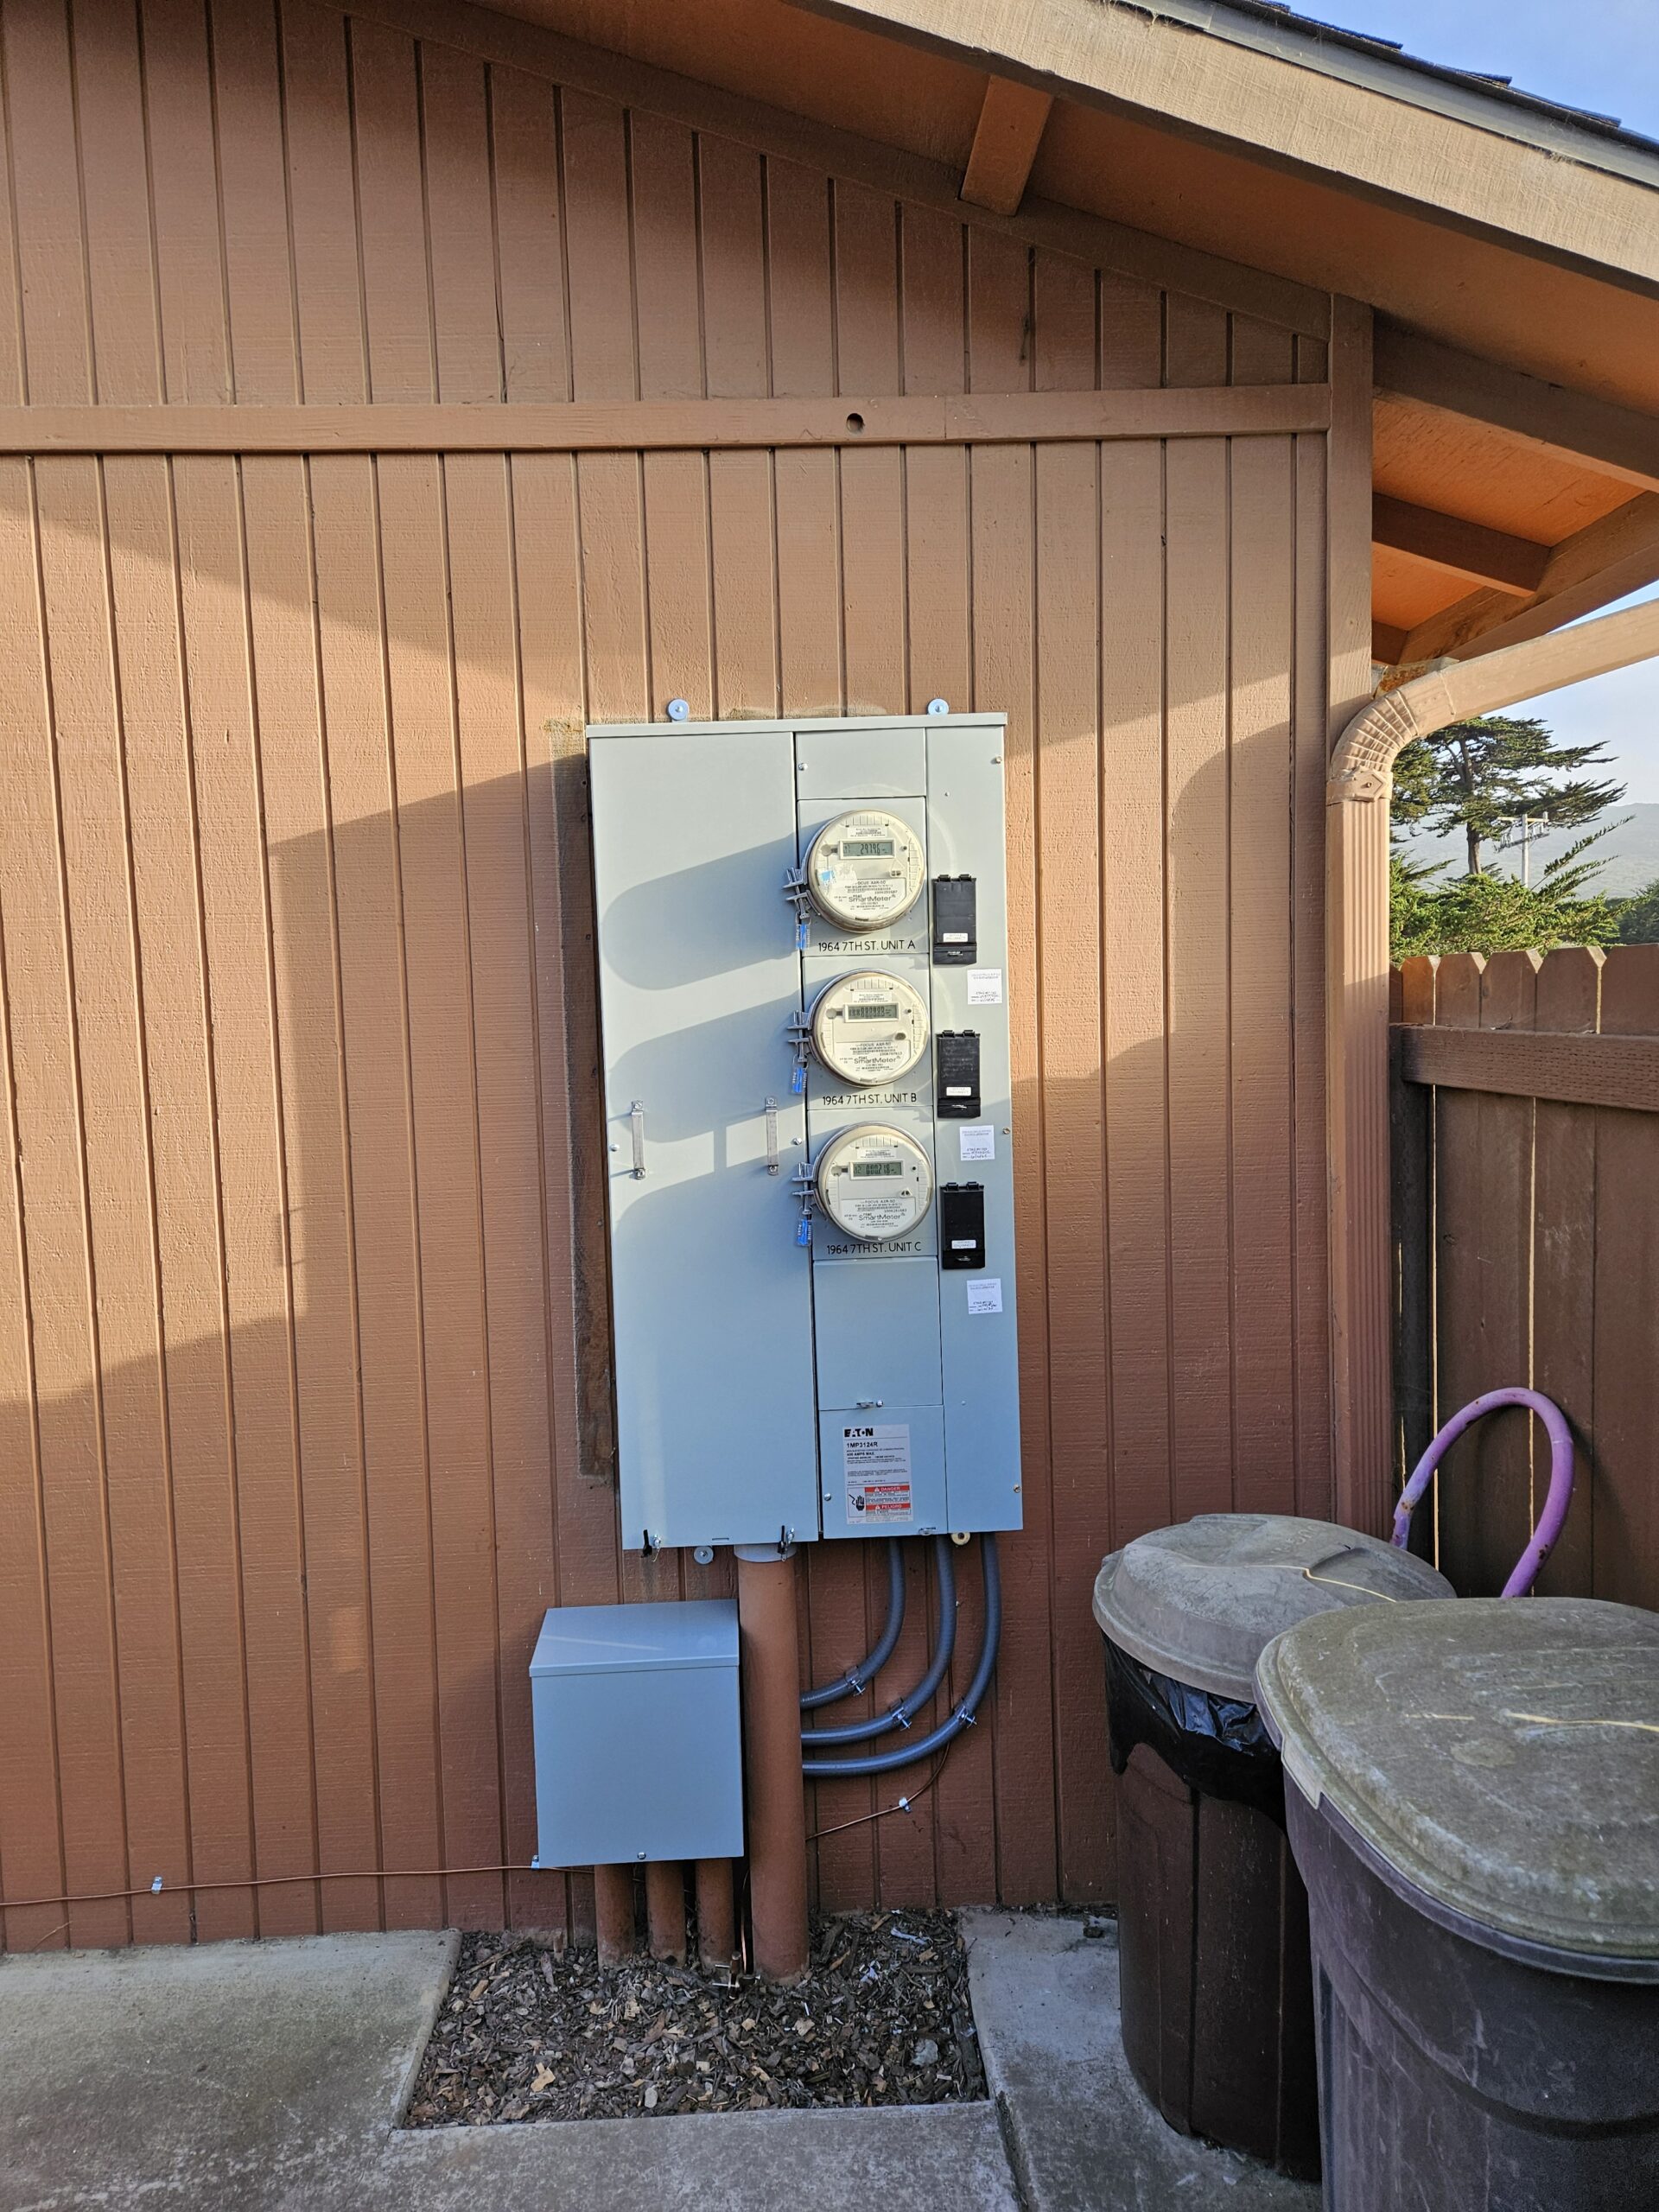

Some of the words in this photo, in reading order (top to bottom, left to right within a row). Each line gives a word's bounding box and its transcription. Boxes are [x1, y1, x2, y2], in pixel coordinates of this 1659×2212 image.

[818, 942, 840, 952] 1964
[842, 941, 862, 951] 7TH
[864, 941, 880, 950] ST.
[880, 940, 905, 950] UNIT
[907, 939, 916, 950] A
[823, 1096, 844, 1106] 1964
[847, 1095, 867, 1104] 7TH
[868, 1094, 883, 1104] ST.
[884, 1093, 908, 1103] UNIT
[911, 1093, 917, 1103] B
[858, 1212, 901, 1221] SmartMeter
[827, 1244, 849, 1255] 1964
[851, 1243, 871, 1254] 7TH
[872, 1243, 887, 1253] ST.
[888, 1242, 912, 1252] UNIT
[914, 1242, 922, 1251] C
